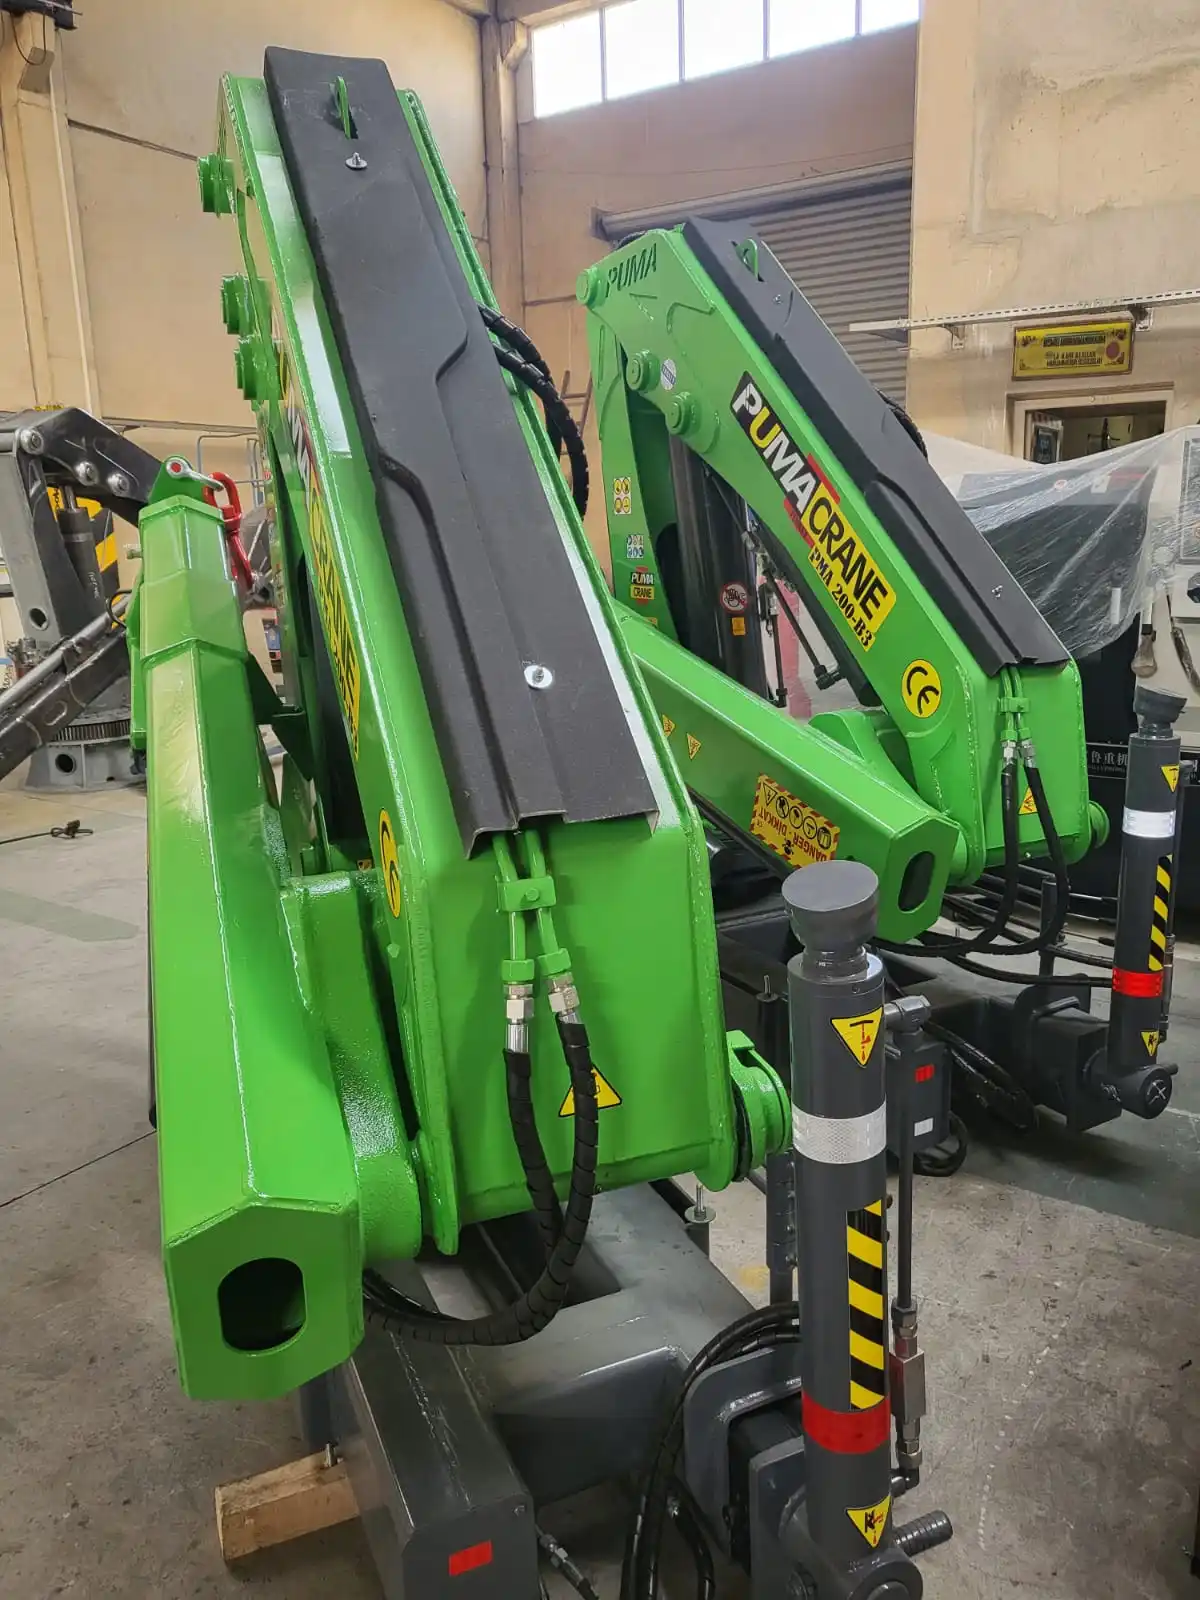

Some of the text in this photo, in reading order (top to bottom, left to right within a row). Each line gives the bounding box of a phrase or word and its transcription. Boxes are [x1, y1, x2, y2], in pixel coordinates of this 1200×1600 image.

[605, 243, 656, 298] PUMA
[632, 573, 654, 585] PUMA
[633, 587, 652, 599] CRANE
[811, 547, 873, 645] PMA 200-B3
[907, 666, 939, 715] CE
[381, 819, 400, 910] CE
